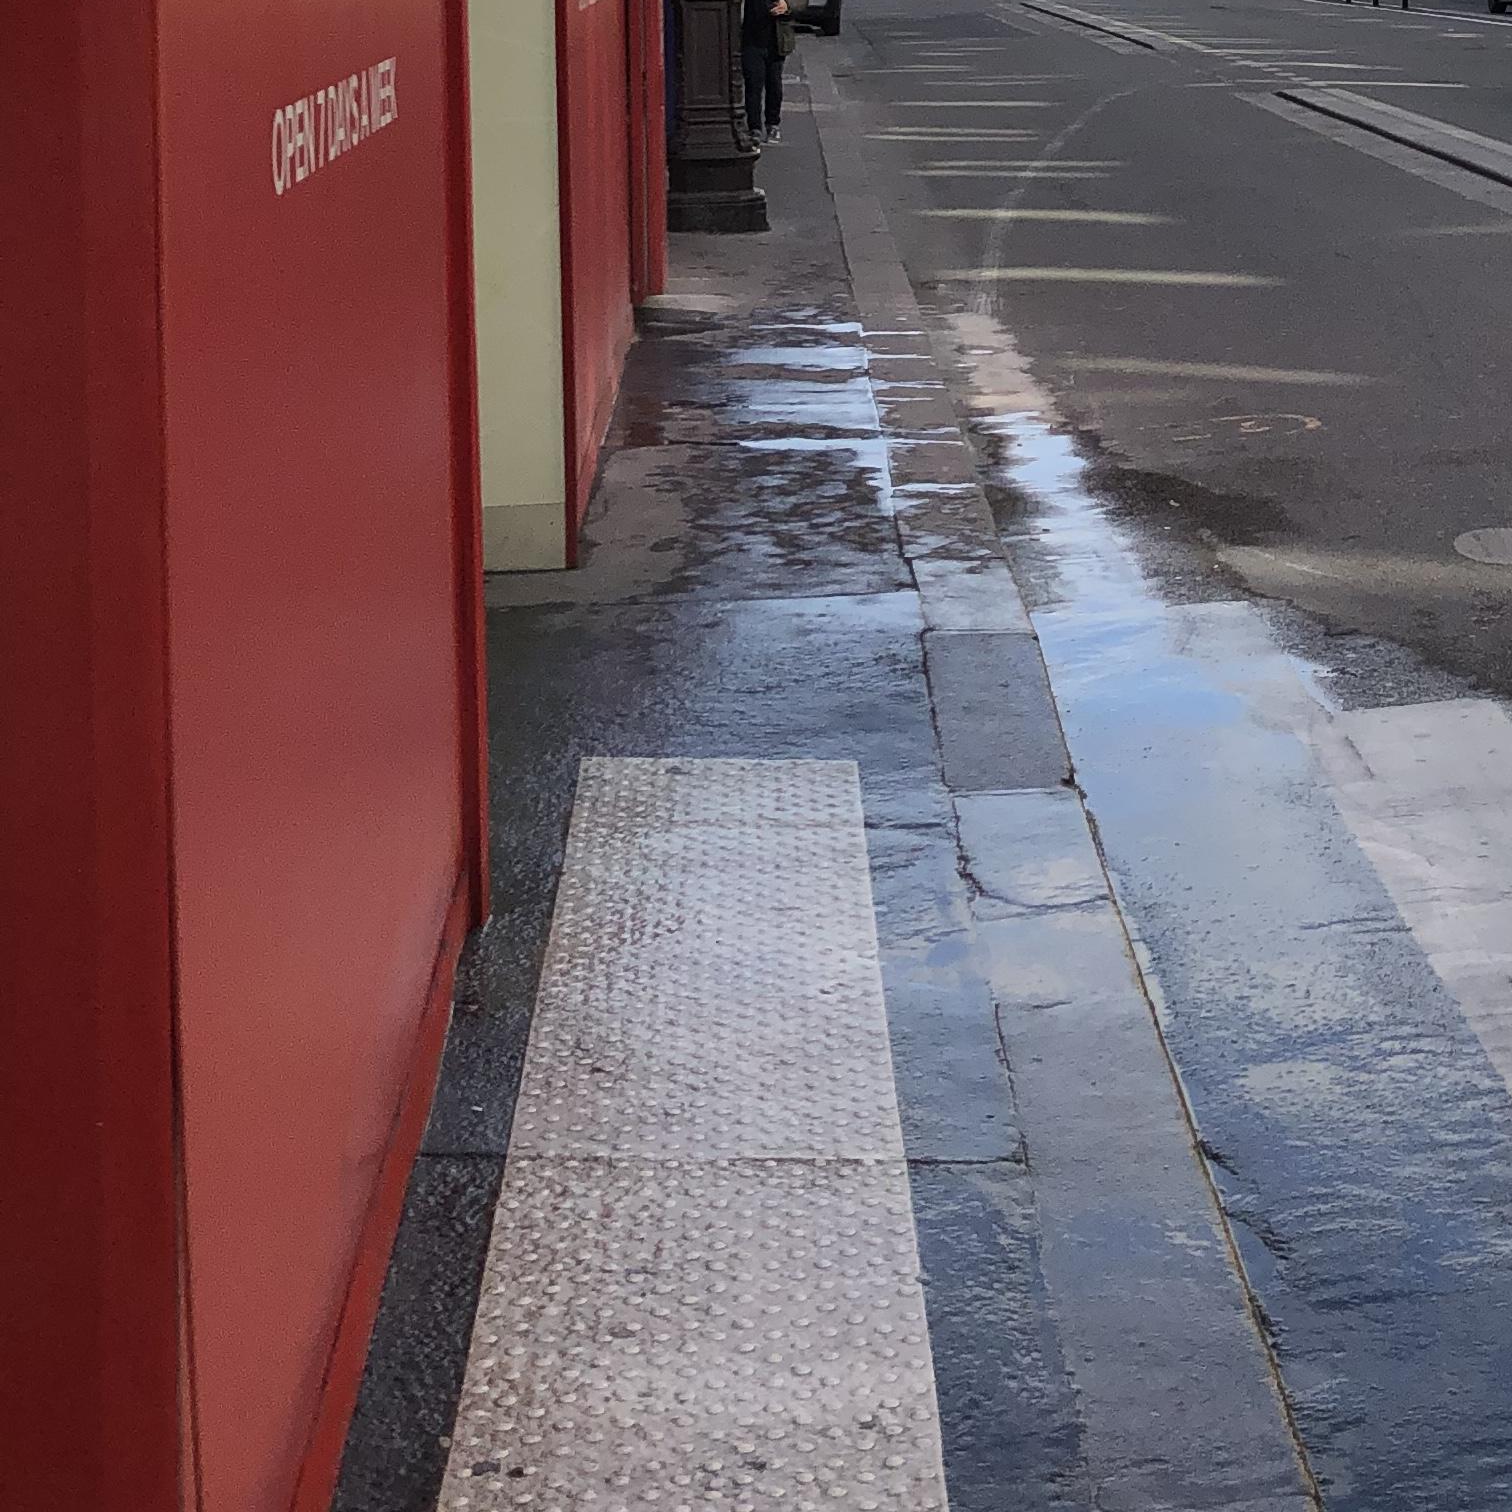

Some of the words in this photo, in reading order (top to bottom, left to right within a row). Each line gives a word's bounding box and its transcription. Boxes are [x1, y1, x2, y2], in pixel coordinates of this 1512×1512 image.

[272, 93, 316, 196] OPEN
[316, 89, 326, 169] 7
[359, 70, 369, 141] A
